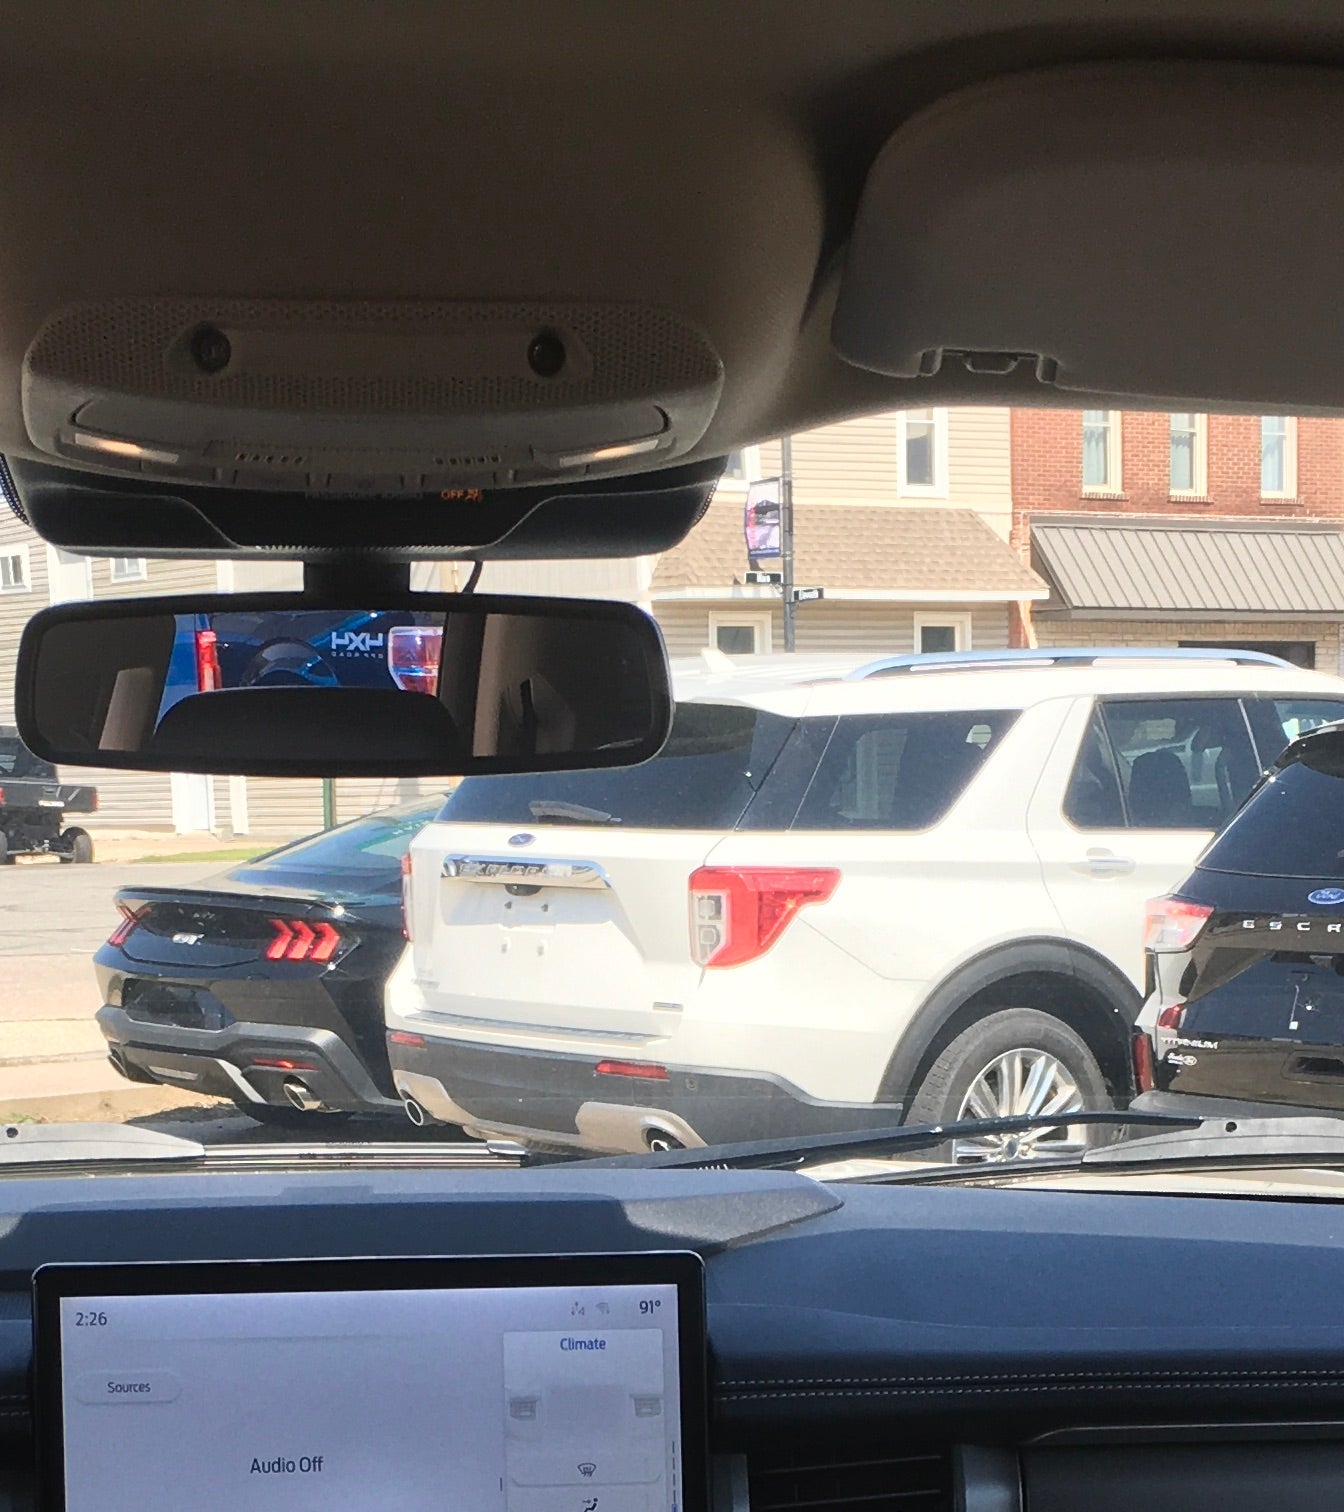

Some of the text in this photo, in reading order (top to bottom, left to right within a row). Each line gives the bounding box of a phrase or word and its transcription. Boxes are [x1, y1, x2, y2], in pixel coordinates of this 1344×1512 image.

[639, 1299, 661, 1315] 91°
[75, 1311, 108, 1328] 2:26
[560, 1336, 607, 1353] Climate
[107, 1379, 151, 1394] Sources
[250, 1455, 324, 1475] Audio Off
